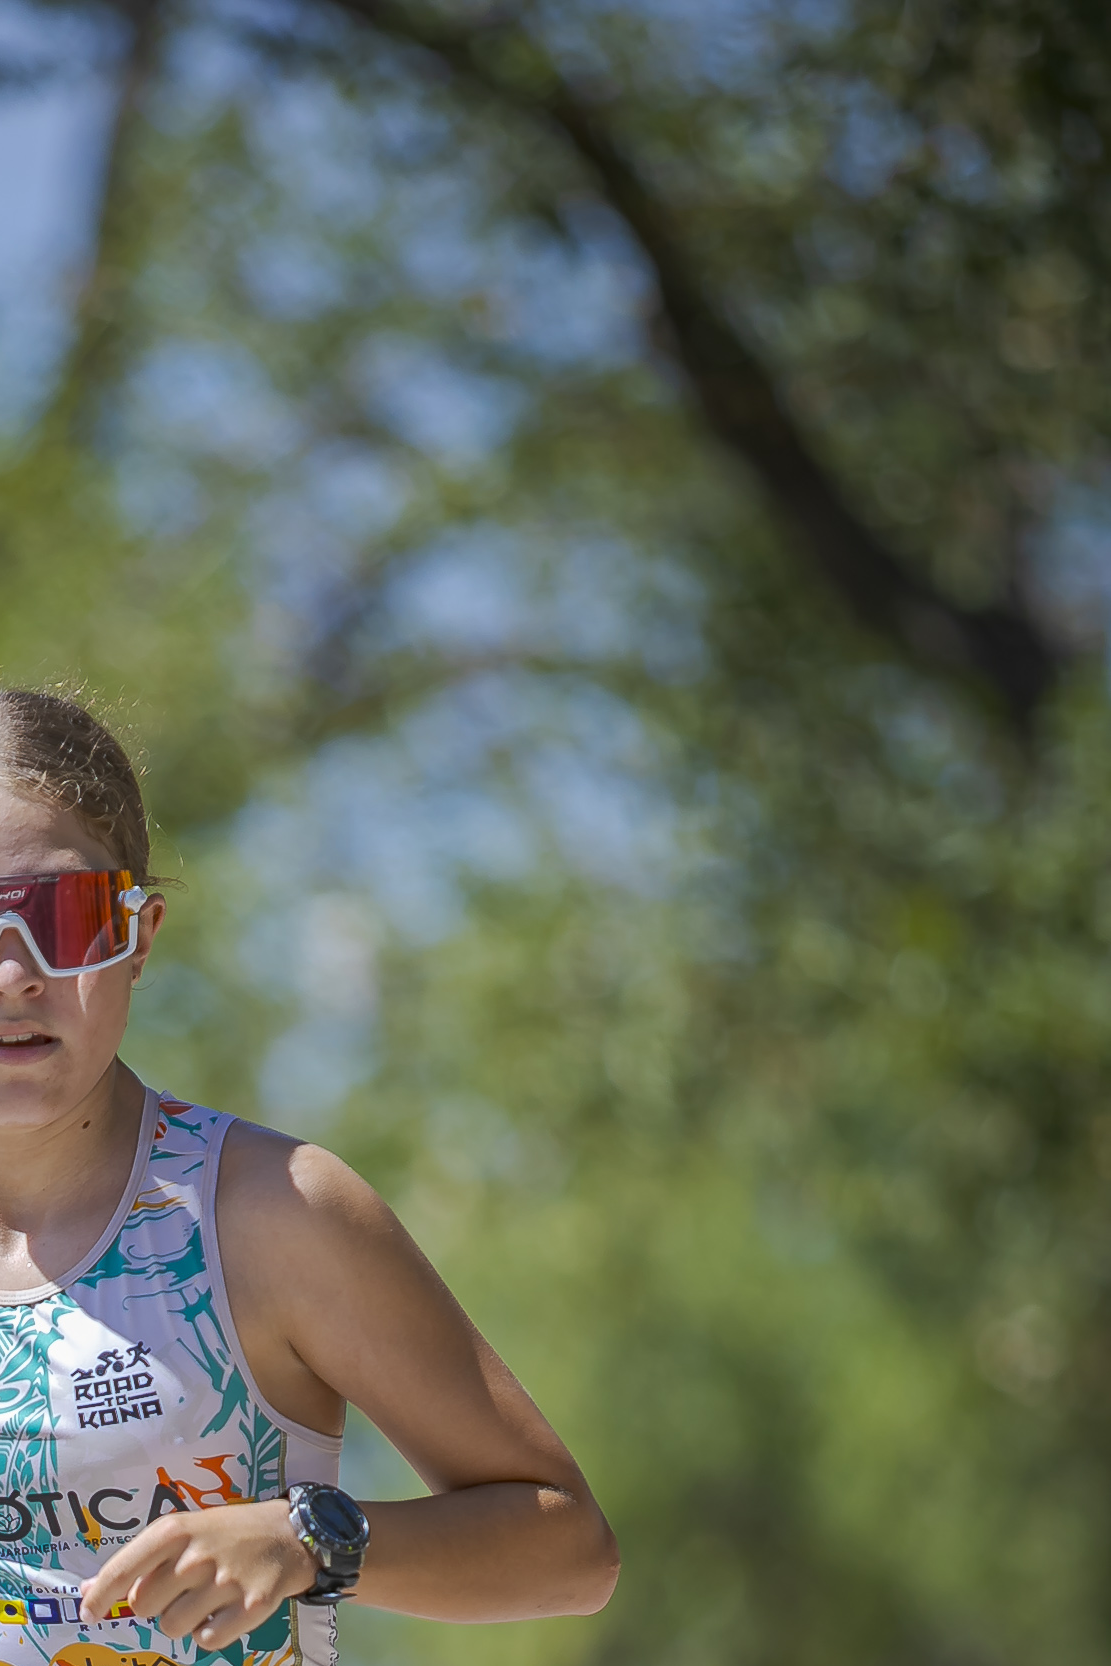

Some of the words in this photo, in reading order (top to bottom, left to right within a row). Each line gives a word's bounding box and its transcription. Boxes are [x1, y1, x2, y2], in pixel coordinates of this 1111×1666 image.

[74, 1371, 154, 1401] ROAD
[104, 1394, 128, 1407] TO
[78, 1399, 163, 1429] KONA
[0, 1541, 70, 1557] JARDINERÍA
[24, 1585, 79, 1595] Holdin
[80, 1616, 157, 1632] RIPAR
